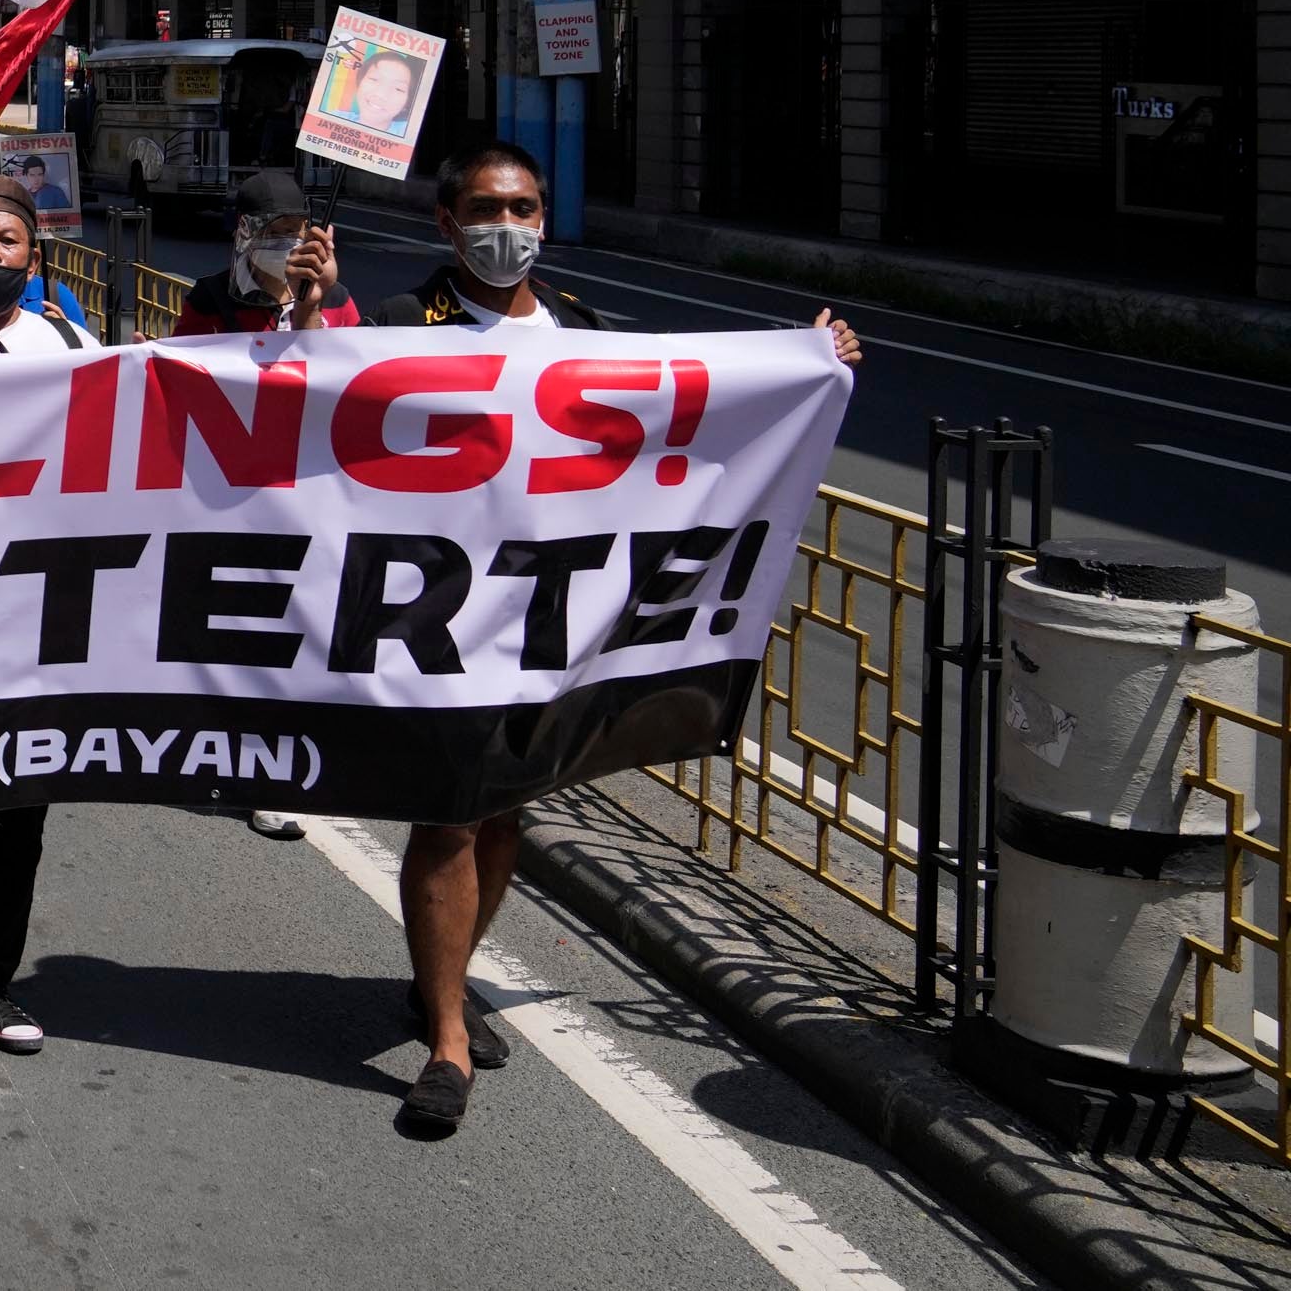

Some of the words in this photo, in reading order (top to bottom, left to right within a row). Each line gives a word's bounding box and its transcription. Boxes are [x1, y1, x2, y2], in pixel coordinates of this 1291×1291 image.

[538, 15, 594, 27] CLAMPING
[336, 12, 440, 58] HUSTISYA!
[555, 28, 579, 37] AND
[545, 38, 590, 49] TOWING
[553, 51, 584, 61] ZONE
[317, 119, 362, 139] JAYROSS
[0, 137, 73, 151] HUSTISYA!
[329, 131, 382, 155] BRONDIAL
[305, 134, 360, 158] SEPTEMBER
[361, 152, 376, 163] 24,
[377, 157, 401, 170] 2017
